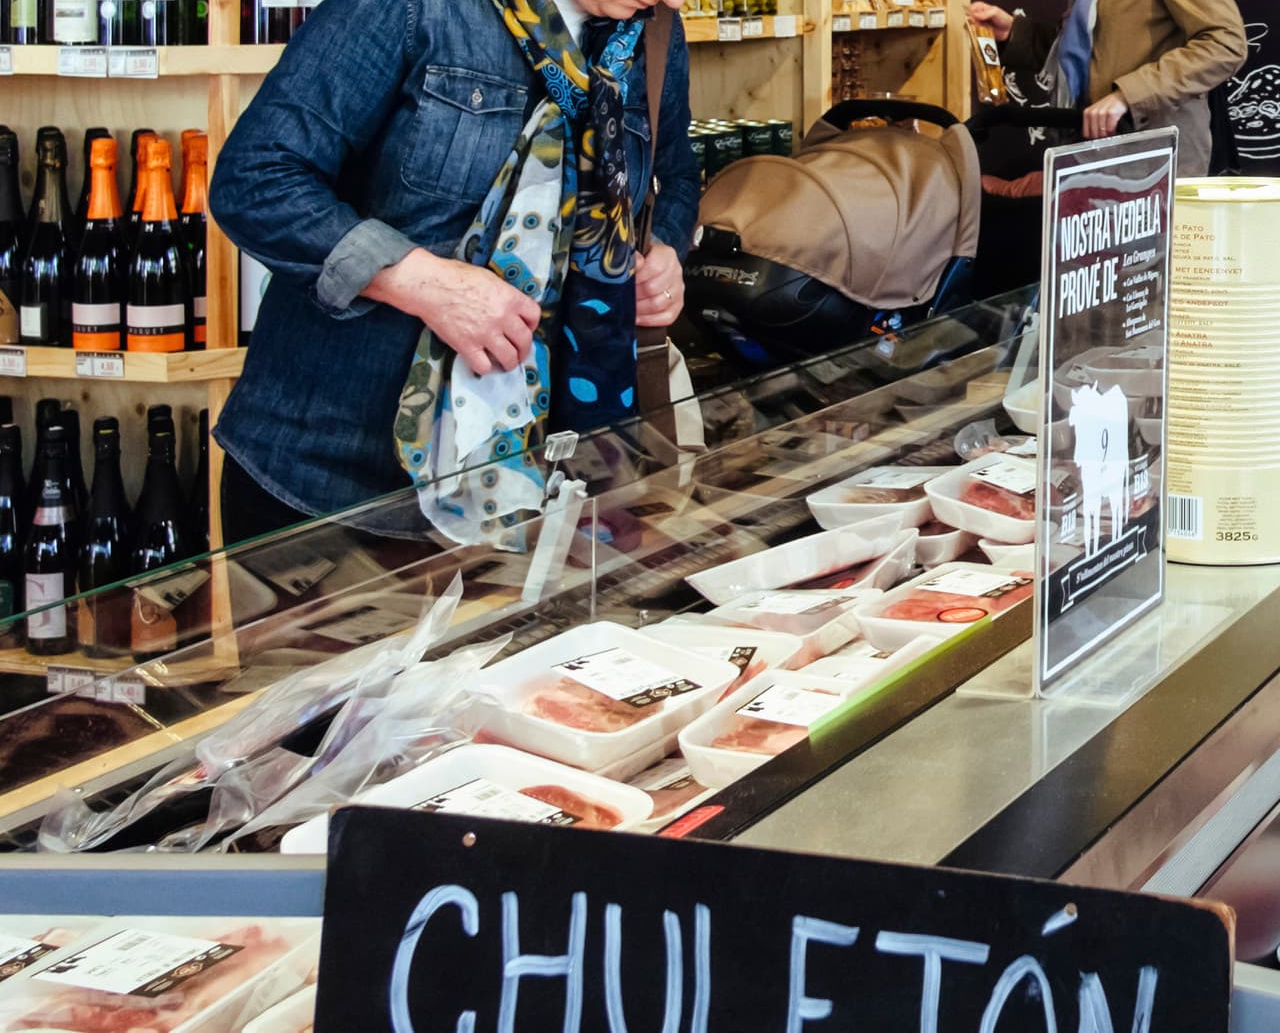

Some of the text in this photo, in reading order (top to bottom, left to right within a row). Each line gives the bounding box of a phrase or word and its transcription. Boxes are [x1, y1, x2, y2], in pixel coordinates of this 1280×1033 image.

[1061, 194, 1161, 262] NOSTRA VEDELLA
[1059, 257, 1102, 319] PROVÉ
[1103, 257, 1119, 303] DE
